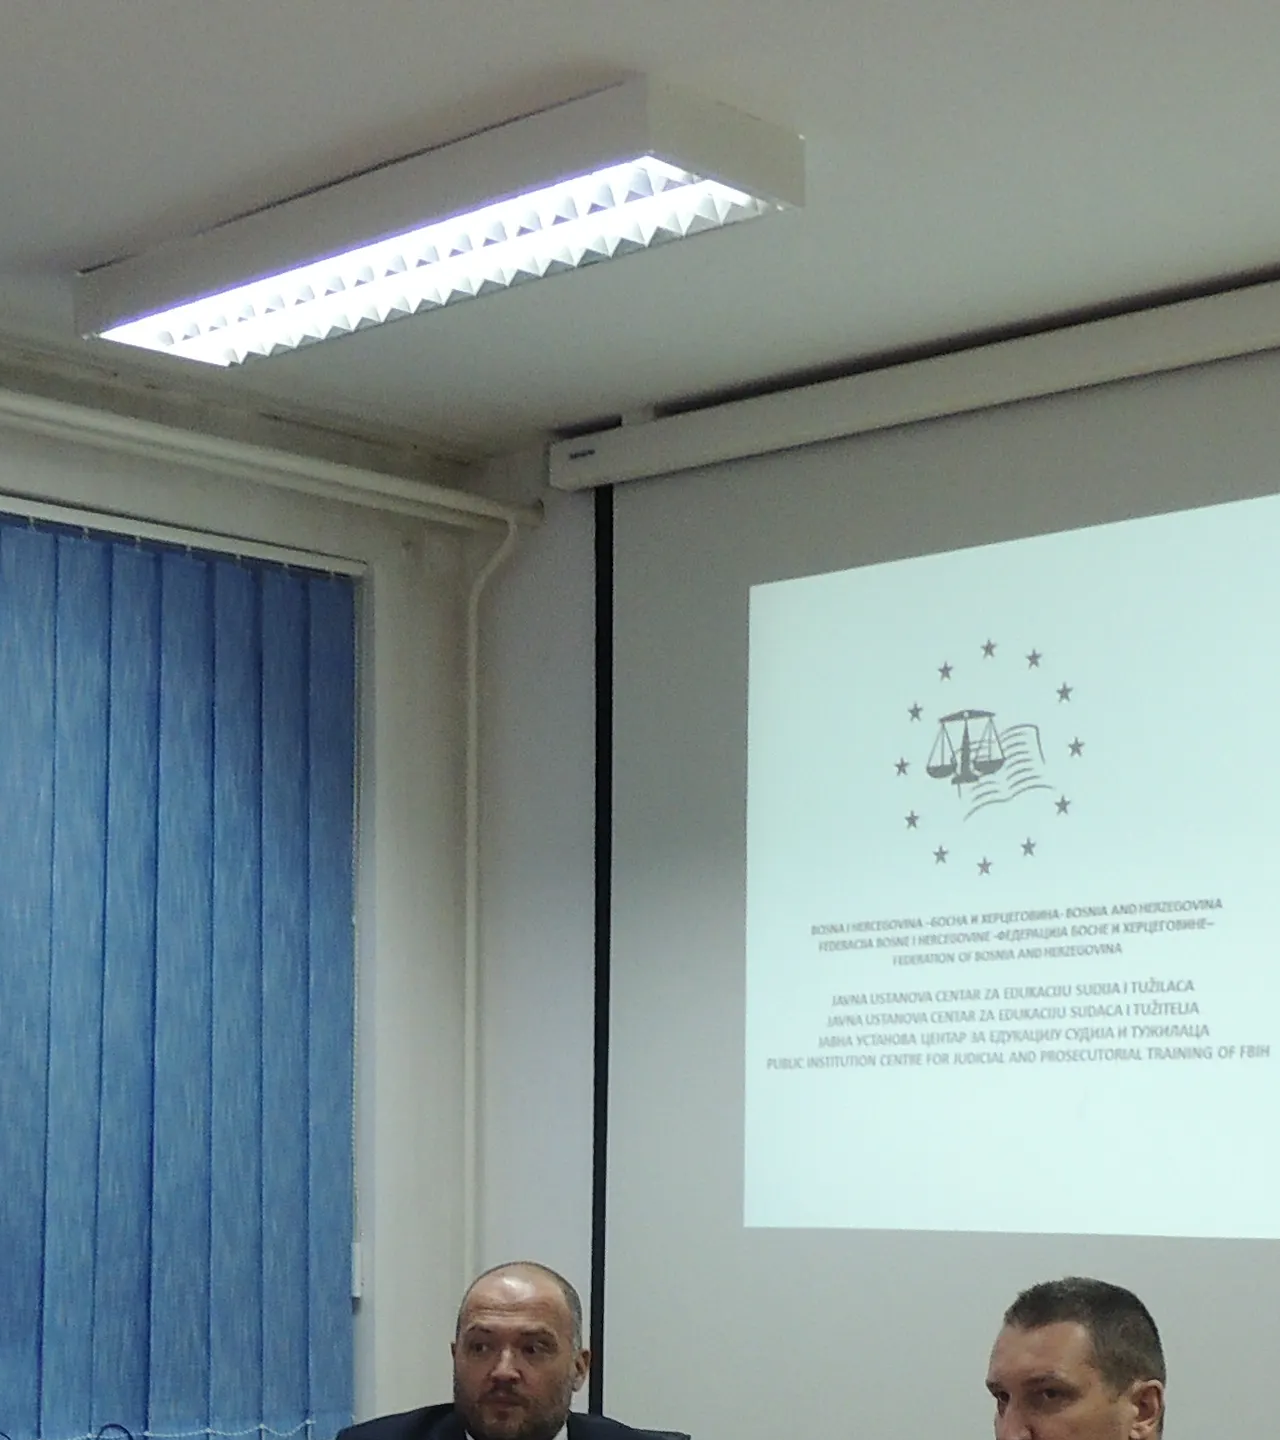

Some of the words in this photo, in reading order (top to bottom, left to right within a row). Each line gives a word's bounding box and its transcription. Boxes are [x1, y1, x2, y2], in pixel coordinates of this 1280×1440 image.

[811, 922, 845, 936] BOSNA
[852, 918, 923, 932] HERCEGOVINA
[1066, 905, 1108, 919] BOSNIA
[1111, 901, 1138, 916] AND
[1139, 897, 1223, 913] HERZEGOVINA
[876, 936, 910, 949] BOSNE
[892, 952, 955, 966] FEDERATION
[958, 951, 973, 963] OF
[974, 949, 1016, 962] BOSNIA
[1018, 947, 1042, 960] AND
[1044, 942, 1123, 959] HERZEGOVINA
[832, 993, 868, 1007] JAVNA
[870, 990, 933, 1005] USTANOVA
[935, 988, 981, 1003] CENTAR
[984, 987, 1000, 1001] ZA
[1003, 984, 1072, 999] EDUKACIJU
[1075, 981, 1122, 997] SUDIJA
[1123, 981, 1128, 995] I
[1131, 976, 1195, 995] TUŽILACA
[827, 1013, 863, 1028] JAVNA
[865, 1011, 928, 1026] USTANOVA
[930, 1009, 976, 1024] CENTAR
[979, 1008, 995, 1022] ZA
[998, 1006, 1067, 1021] EDUKACIJU
[1069, 1004, 1122, 1020] SUDACA
[1126, 1004, 1131, 1017] I
[818, 1034, 853, 1049] ЈАВНА
[856, 1032, 917, 1048] УСТАНОВА
[920, 1031, 967, 1048] ЦЕНТАР
[971, 1030, 986, 1043] ЗА
[989, 1028, 1062, 1045] ЕДУКАЦИЈУ
[1065, 1026, 1115, 1043] СУДИЈА
[1118, 1026, 1127, 1039] И
[1131, 1023, 1210, 1040] ТУЖИЛАЦА
[766, 1056, 805, 1071] PUBLIC
[807, 1053, 876, 1069] INSTITUTION
[879, 1053, 923, 1067] CENTRE
[926, 1052, 950, 1066] FOR
[953, 1051, 1004, 1067] JUDICIAL
[1009, 1050, 1037, 1064] AND
[1040, 1047, 1143, 1063] PROSECUTORIAL
[1147, 1046, 1213, 1061] TRAINING
[1218, 1045, 1236, 1060] OF
